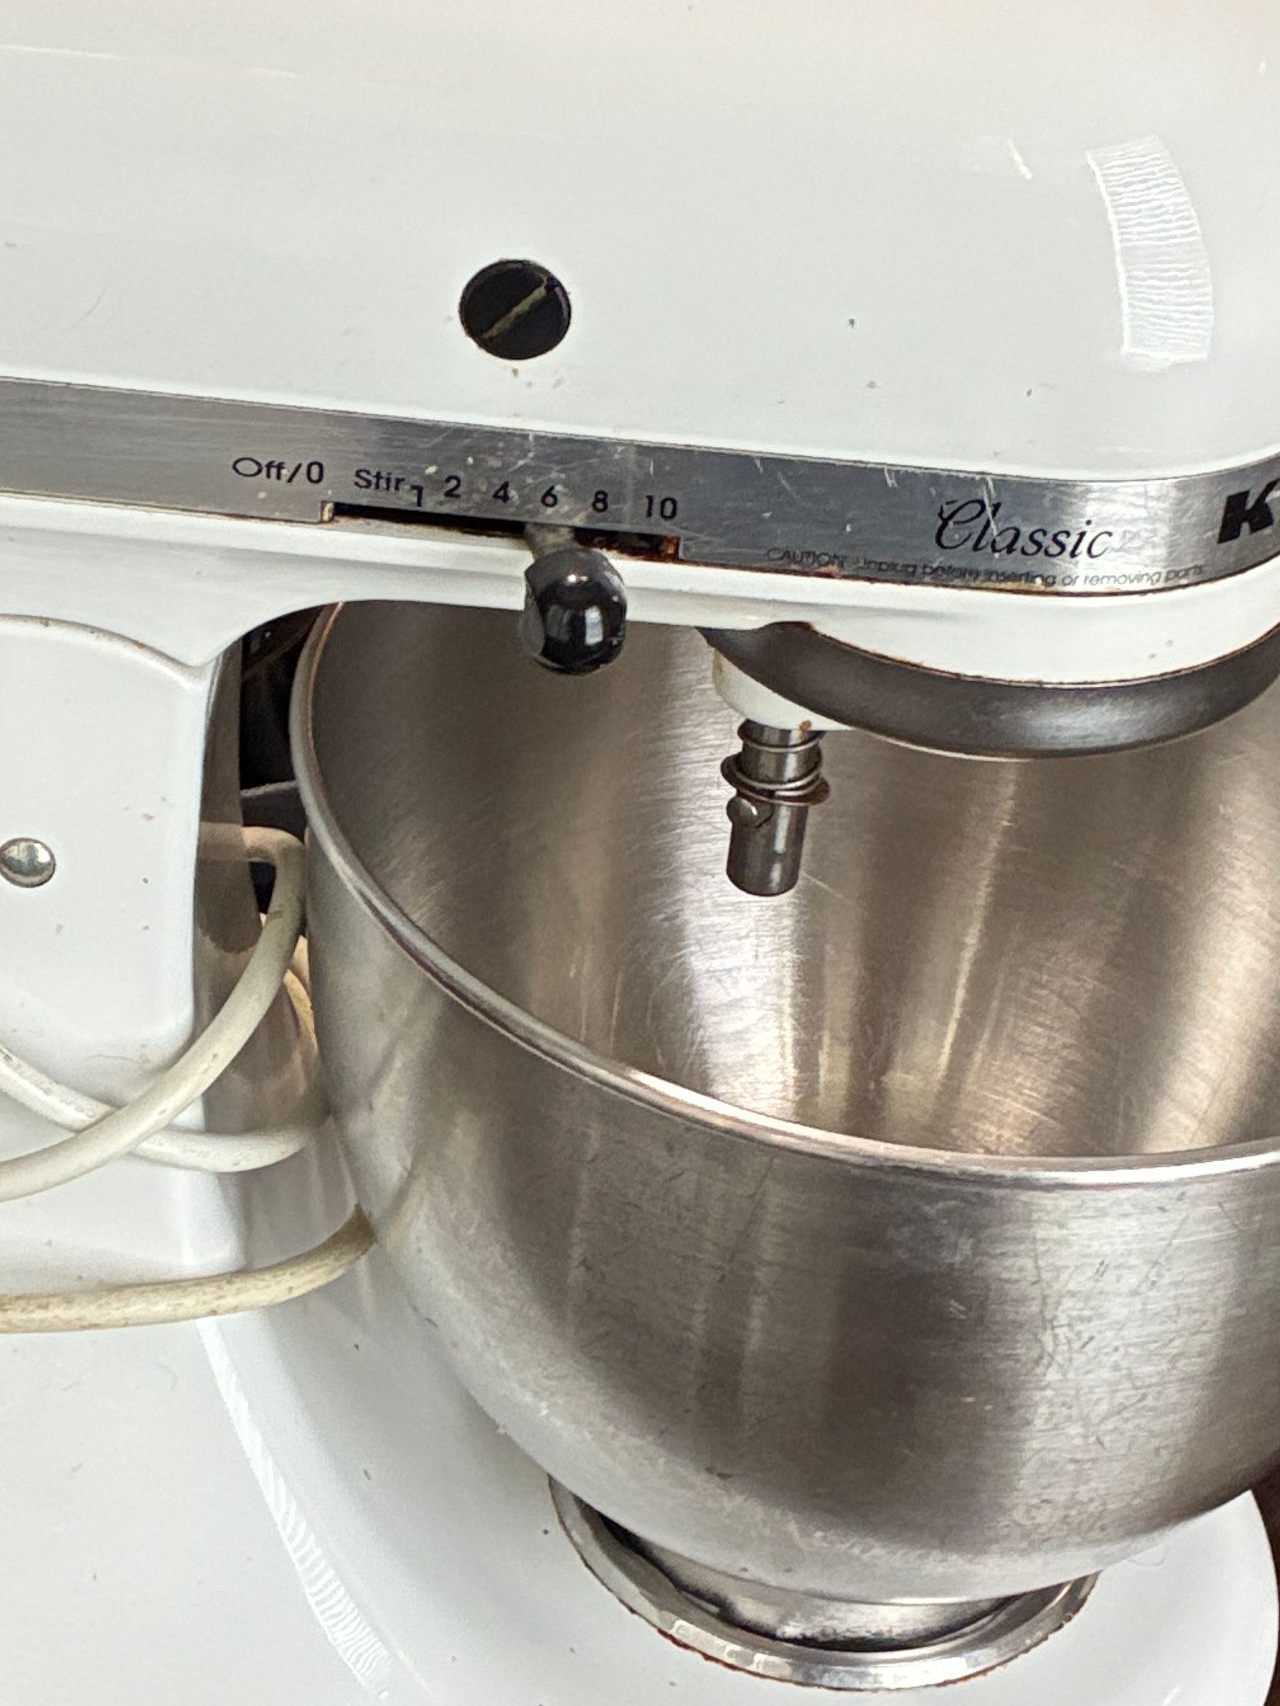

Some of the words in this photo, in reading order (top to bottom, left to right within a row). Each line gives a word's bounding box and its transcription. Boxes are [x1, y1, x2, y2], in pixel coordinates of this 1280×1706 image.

[232, 457, 324, 483] Off/0
[354, 468, 405, 492] Stir
[443, 475, 461, 499] 2
[493, 483, 511, 504] 4
[540, 486, 559, 508] 6
[592, 490, 610, 513] 8
[645, 495, 678, 520] 10
[934, 498, 1113, 559] Classic
[1062, 573, 1079, 585] or
[1083, 570, 1163, 587] removing
